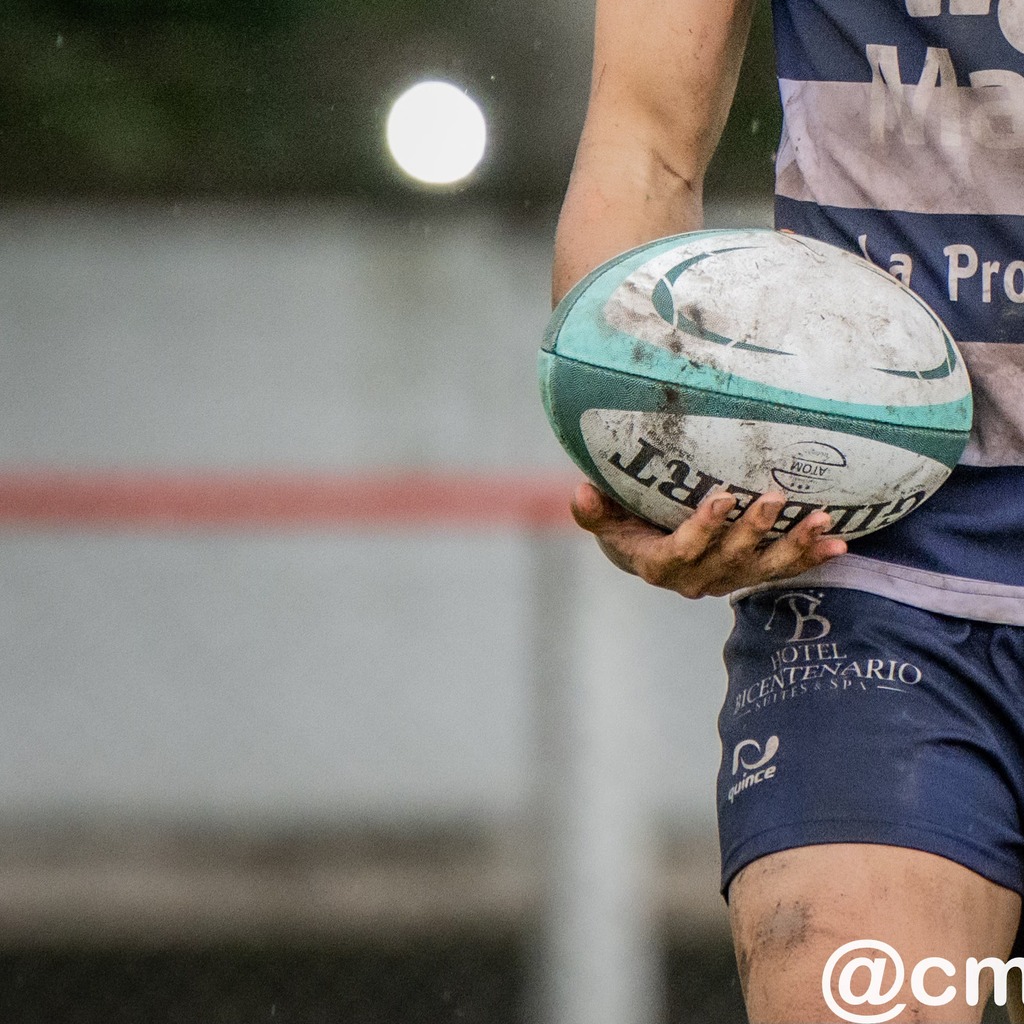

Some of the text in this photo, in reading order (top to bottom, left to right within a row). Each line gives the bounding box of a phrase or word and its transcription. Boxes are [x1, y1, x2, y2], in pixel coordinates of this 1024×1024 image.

[789, 460, 829, 477] ATOM
[770, 642, 848, 672] HOTEL
[727, 764, 777, 804] quince
